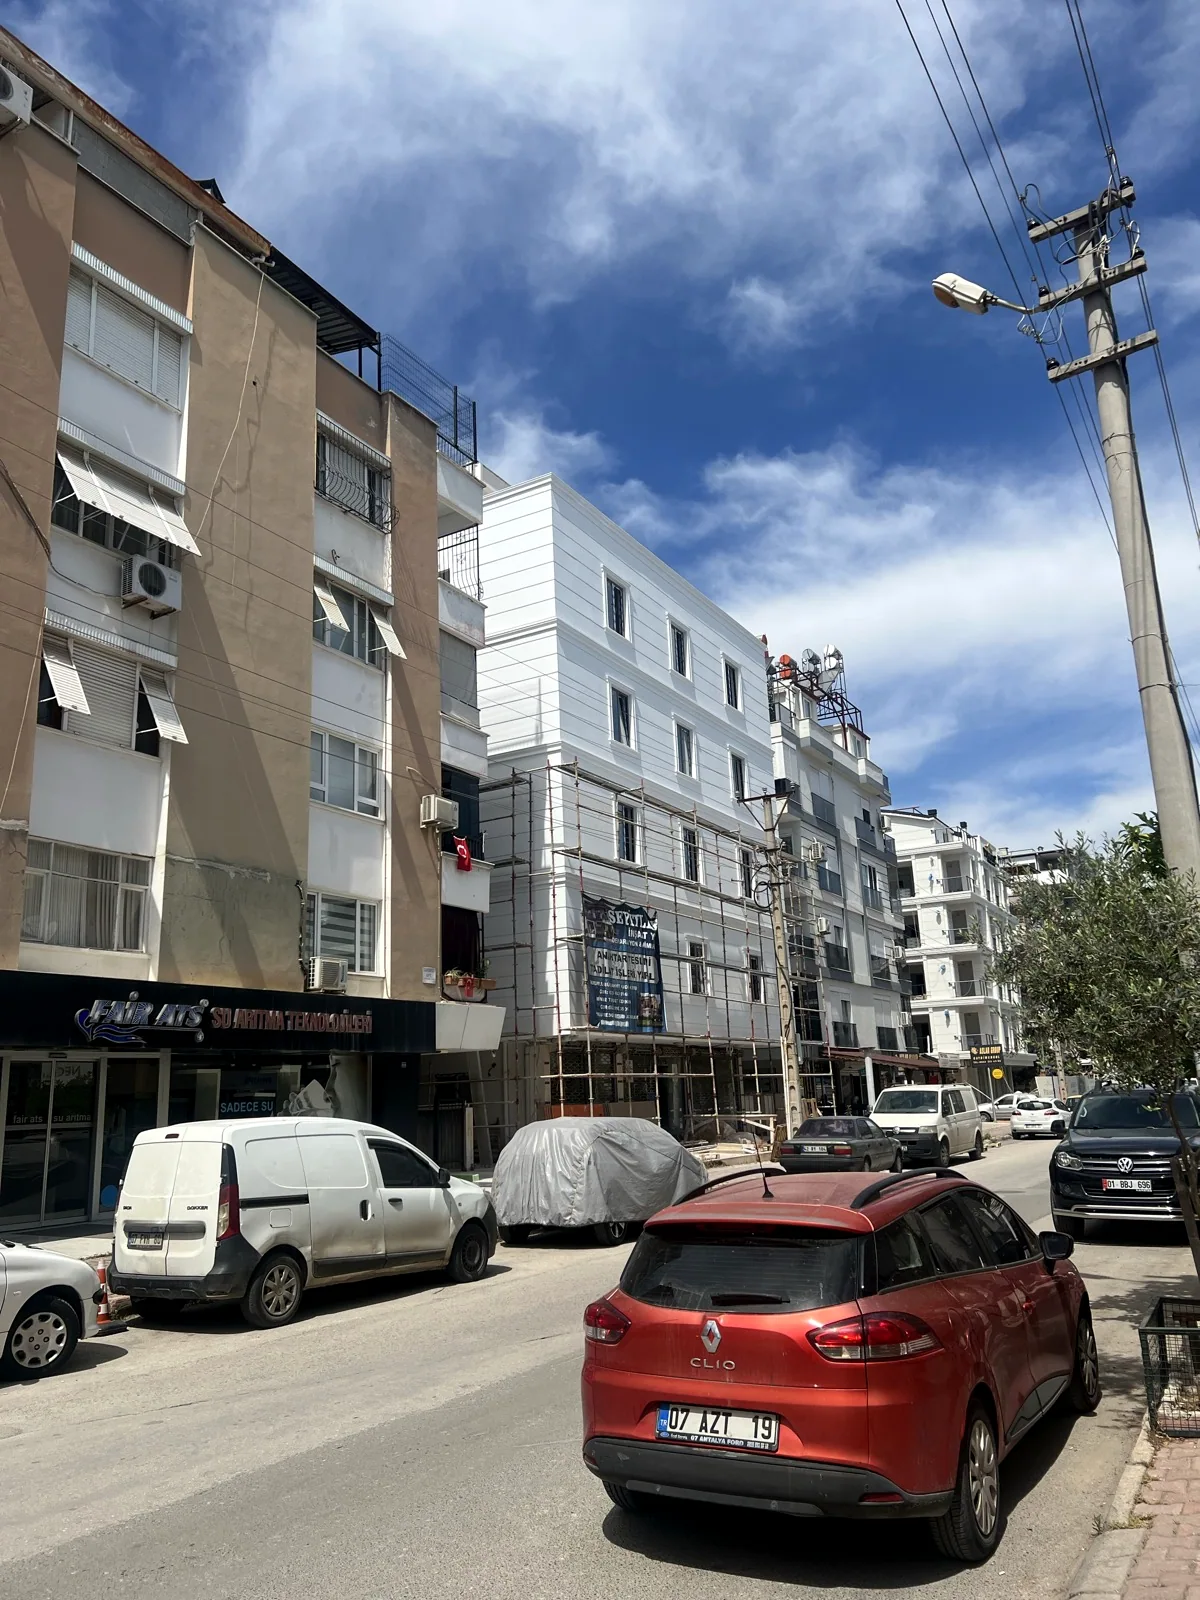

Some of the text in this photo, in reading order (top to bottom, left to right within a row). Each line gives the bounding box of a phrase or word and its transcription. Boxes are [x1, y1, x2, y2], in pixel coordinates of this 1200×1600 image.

[210, 1007, 232, 1029] SU
[232, 1008, 285, 1031] ARITMA
[220, 1100, 274, 1113] SADECE SU
[13, 1114, 28, 1124] fair
[29, 1114, 43, 1123] ats
[1107, 1180, 1151, 1189] 01 BBJ 696
[690, 1357, 736, 1371] CLIO
[669, 1407, 690, 1430] 07
[699, 1410, 732, 1435] AZT
[752, 1415, 773, 1440] 19
[699, 1436, 726, 1445] ANTALYA
[727, 1438, 744, 1446] FORD
